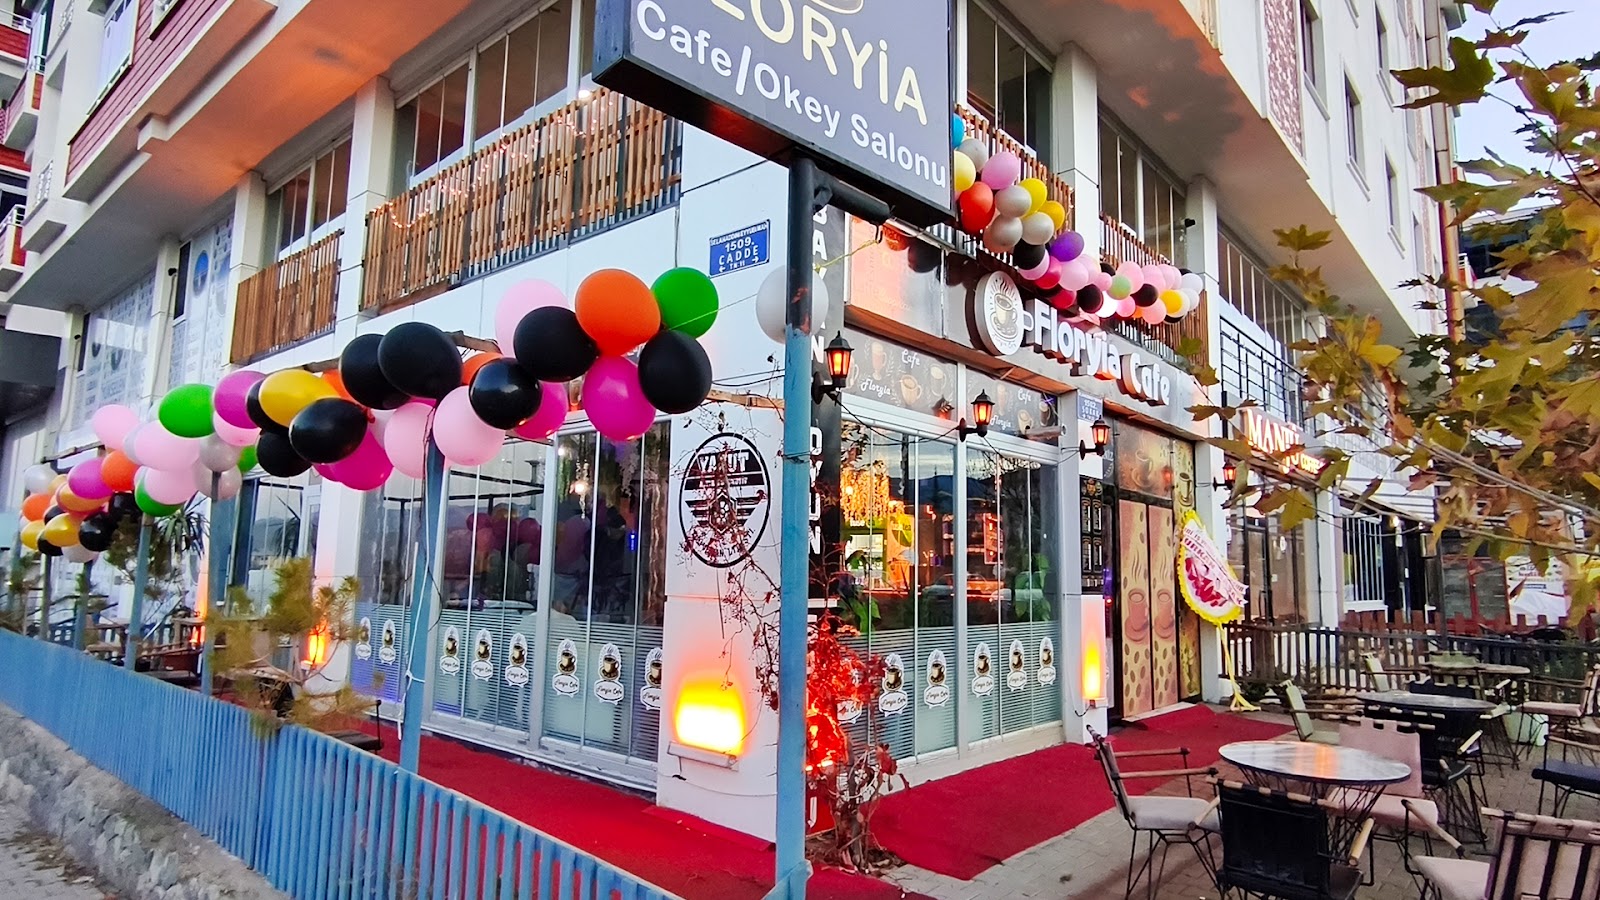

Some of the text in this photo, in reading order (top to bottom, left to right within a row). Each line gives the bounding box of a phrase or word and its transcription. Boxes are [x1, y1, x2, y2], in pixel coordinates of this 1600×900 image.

[636, 2, 947, 189] Cafe/Okey Salonu
[719, 245, 759, 265] CADDE
[901, 348, 921, 369] Cafe
[1034, 298, 1170, 406] Floryia Cafe
[699, 452, 750, 473] YAUT
